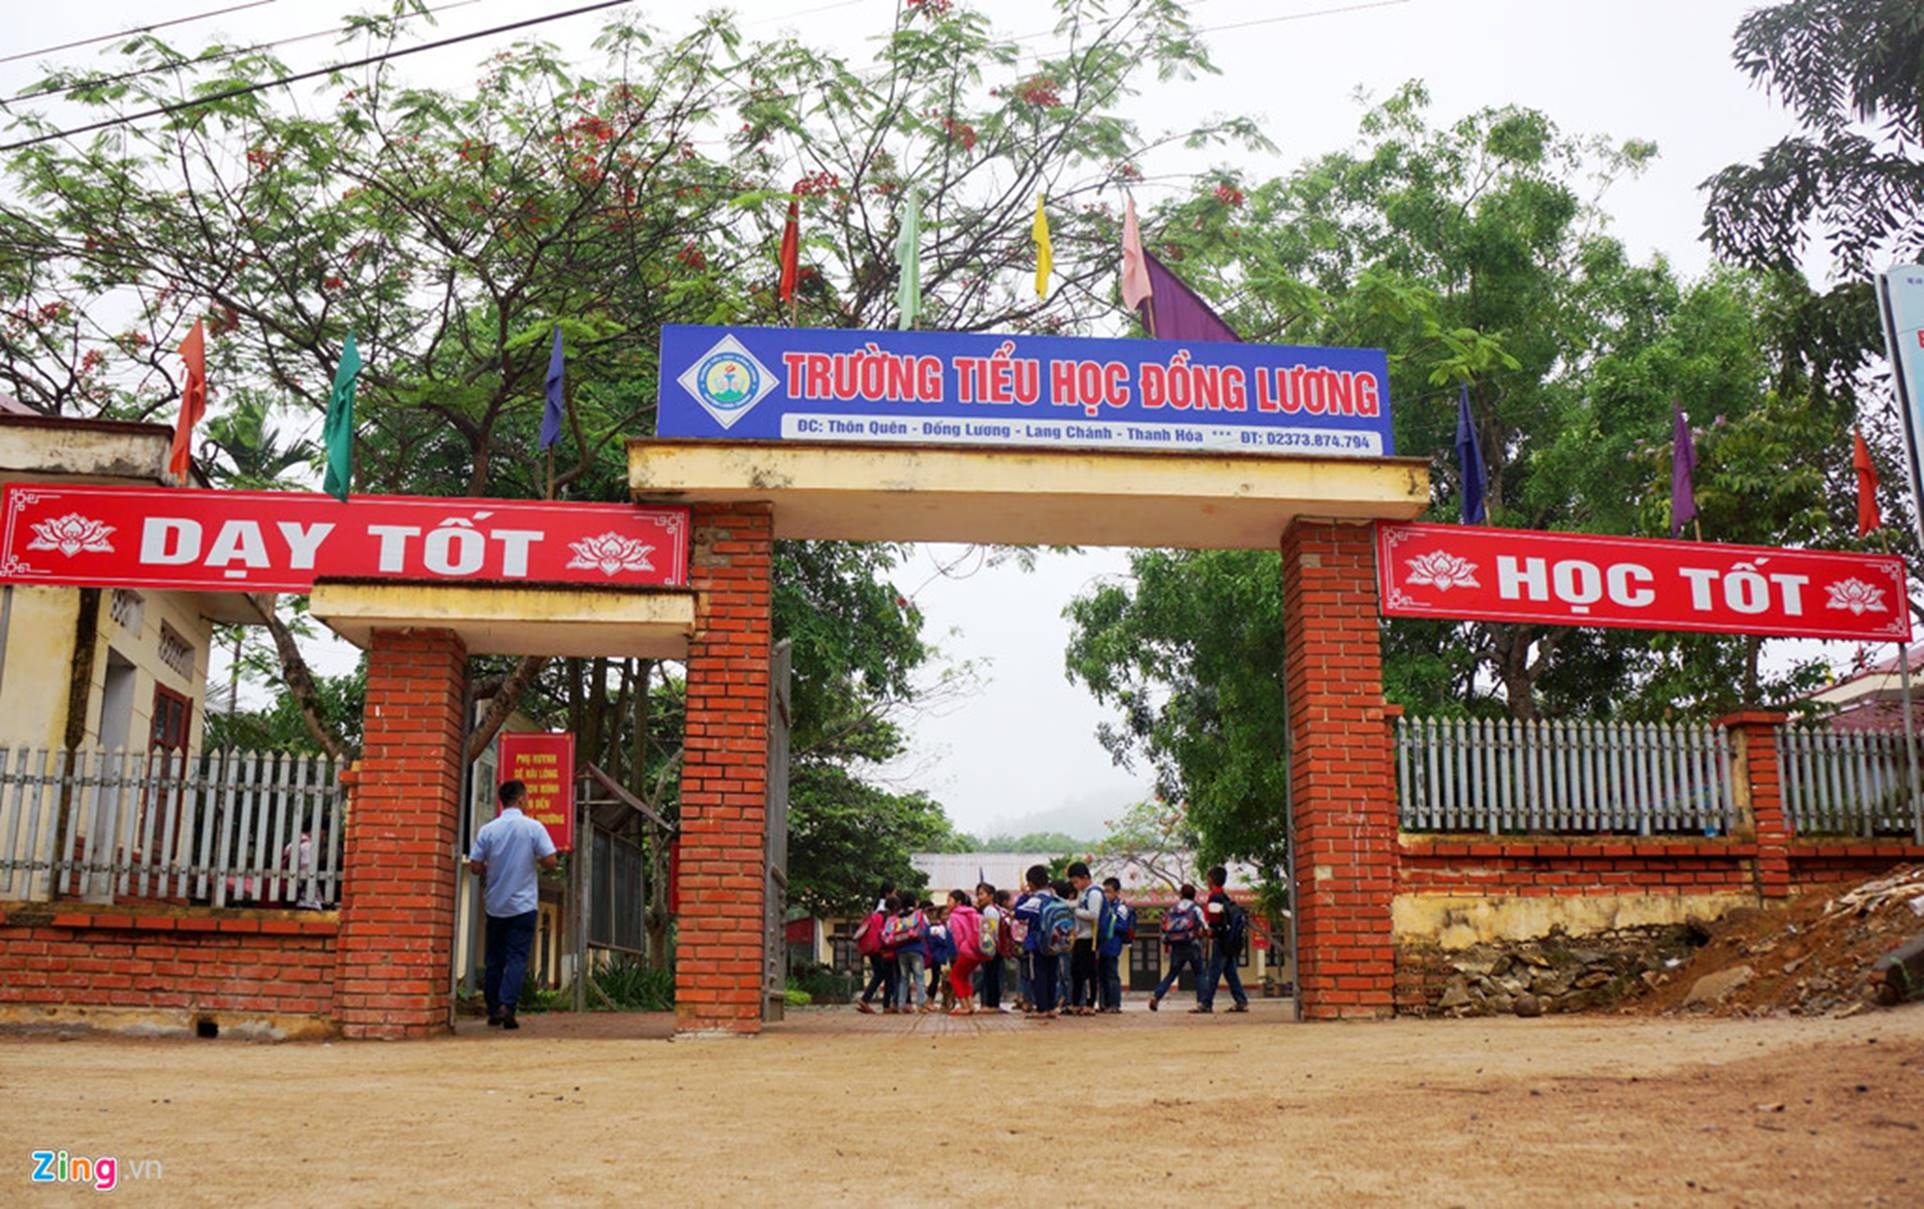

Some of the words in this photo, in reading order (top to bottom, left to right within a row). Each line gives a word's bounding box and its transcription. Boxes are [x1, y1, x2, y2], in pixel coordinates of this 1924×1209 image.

[783, 343, 944, 402] TRƯỜNG
[953, 340, 1040, 405] TIỂU
[1050, 359, 1130, 417] HỌC
[1139, 349, 1247, 411] ĐỒNG
[1255, 364, 1380, 417] LƯƠNG
[828, 419, 864, 434] Thôn
[1026, 424, 1061, 439] Lang
[1127, 427, 1171, 441] Thanh
[1267, 432, 1370, 449] 02373.874.794
[140, 516, 336, 578] DẠY
[368, 511, 544, 577] TỐT
[1496, 555, 1656, 613] HỌC
[1679, 557, 1809, 616] TỐT
